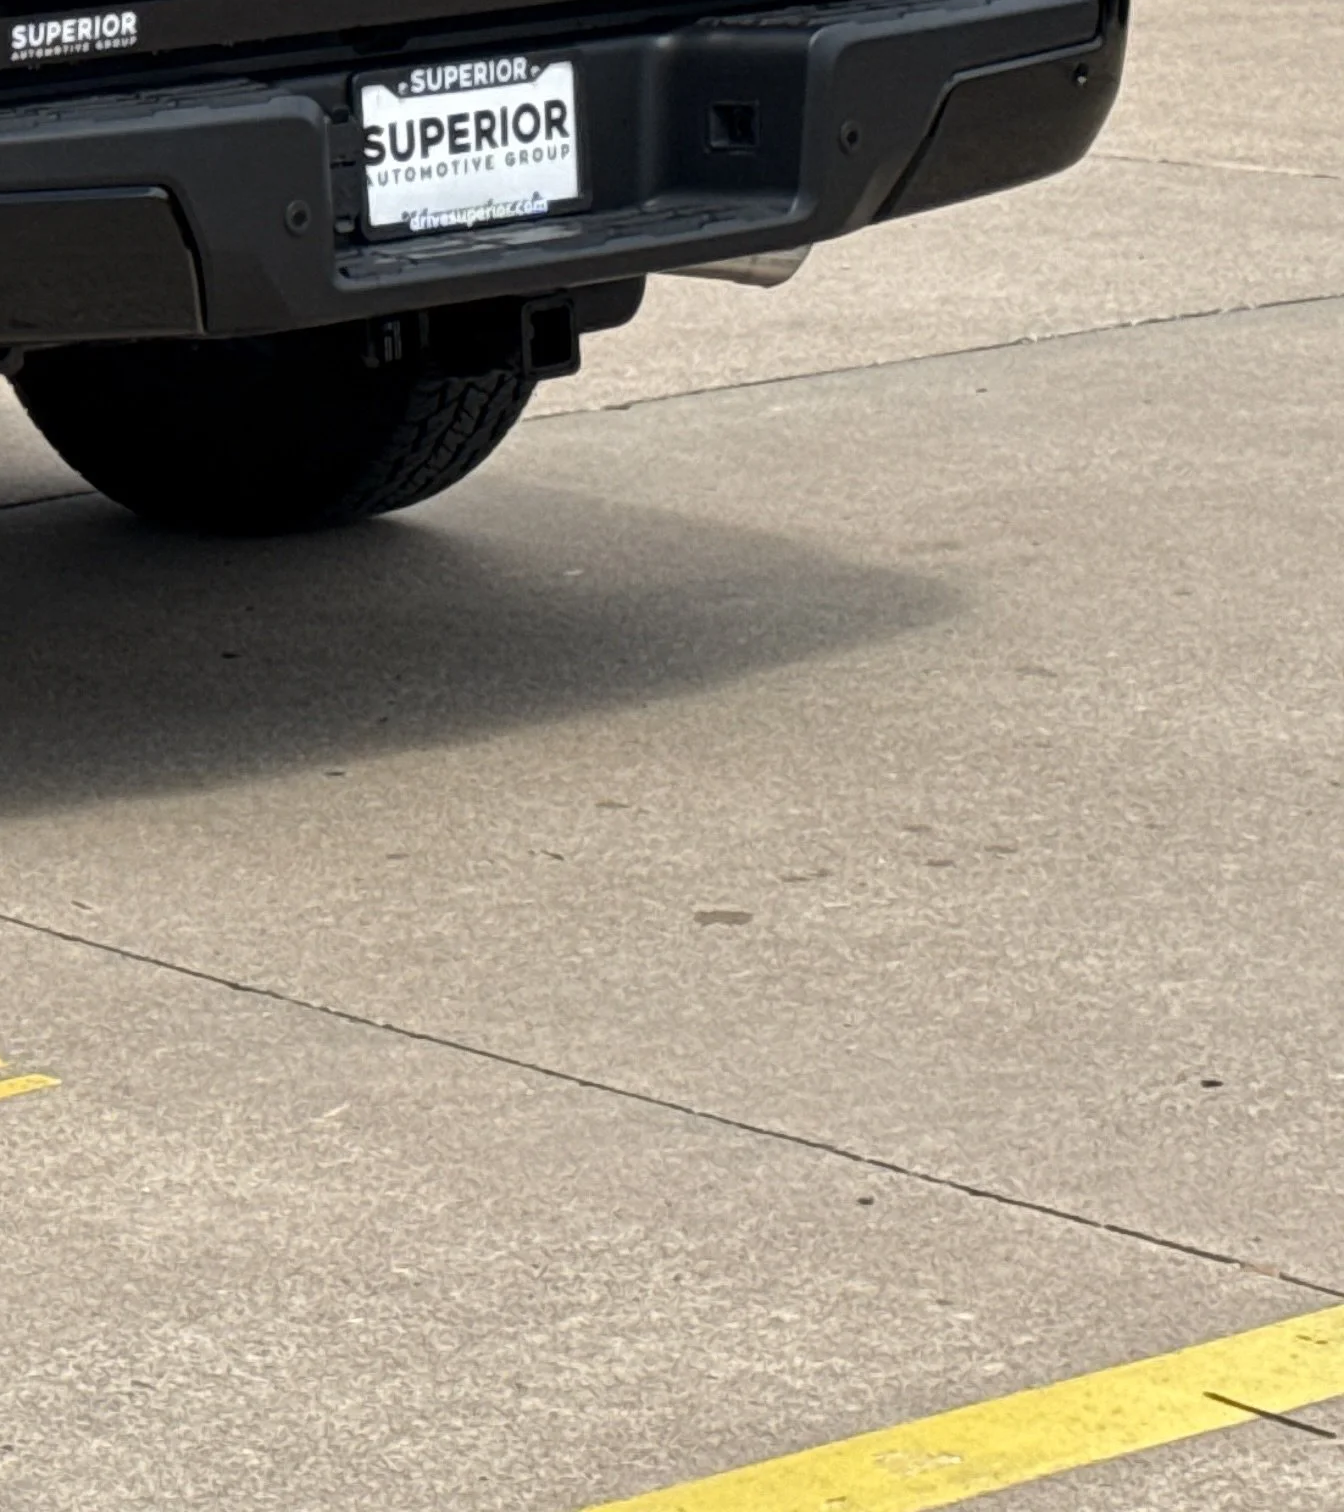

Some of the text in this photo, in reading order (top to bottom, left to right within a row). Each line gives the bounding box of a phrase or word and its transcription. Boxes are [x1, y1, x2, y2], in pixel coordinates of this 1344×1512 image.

[10, 10, 139, 51] SUPERIOR
[410, 56, 529, 94] SUPERIOR
[362, 98, 571, 168] SUPERIOR
[366, 142, 572, 188] AUTOMOTIVE GROUP
[409, 197, 549, 233] drivesuperior.com
